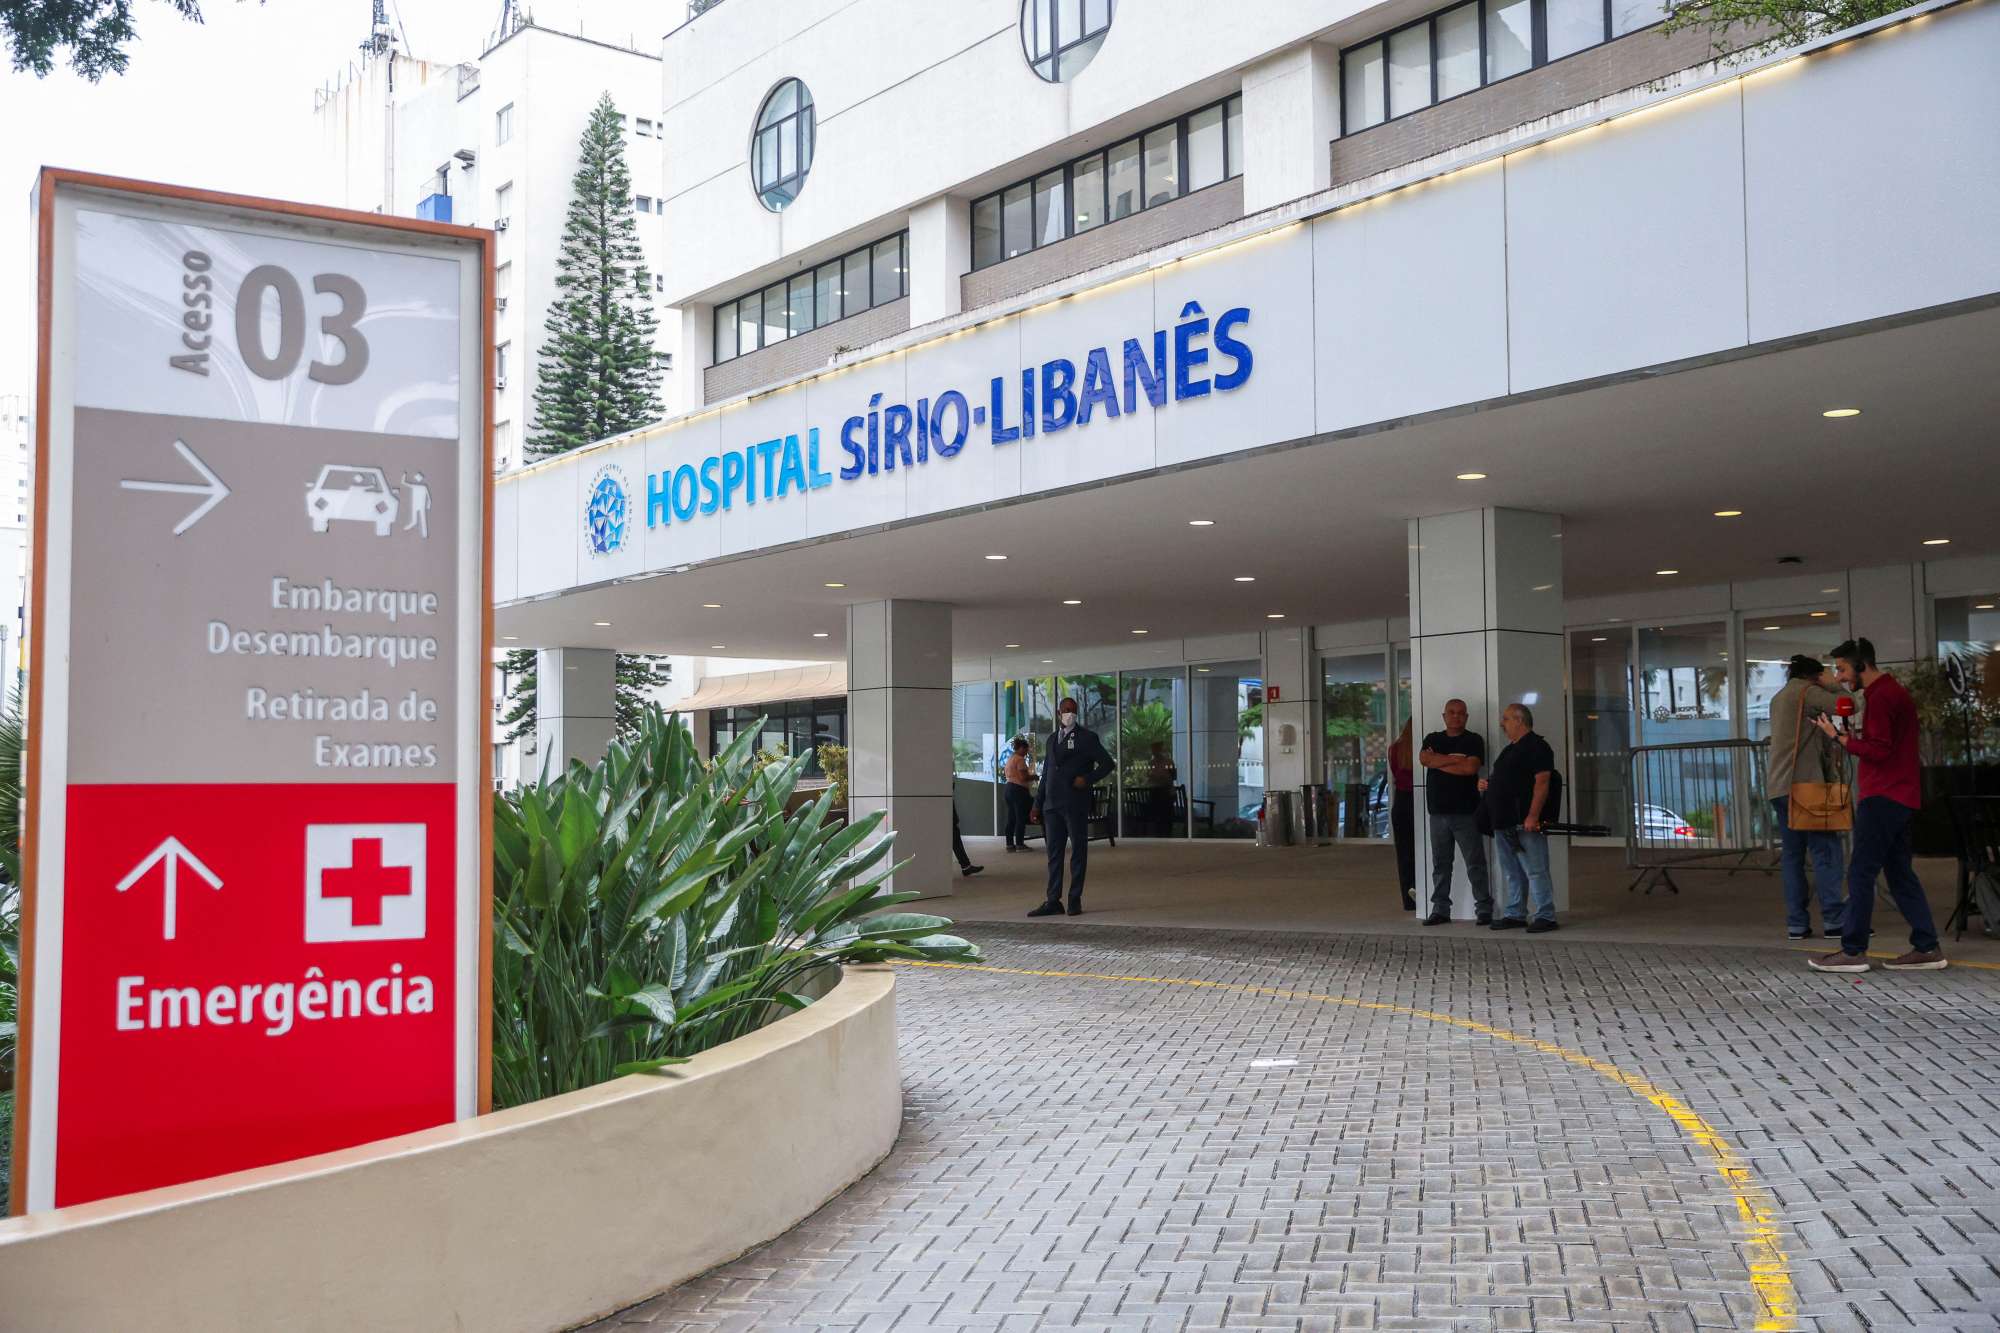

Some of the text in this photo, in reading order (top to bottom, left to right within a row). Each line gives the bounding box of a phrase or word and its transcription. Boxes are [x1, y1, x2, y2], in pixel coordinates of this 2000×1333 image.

[170, 250, 213, 377] Acesso
[235, 264, 370, 386] 03
[646, 299, 1254, 529] HOSPITAL SÍRIO-LIBANÊS
[271, 576, 439, 621] Embarque
[207, 621, 439, 668] Desembarque
[246, 687, 438, 722] Retirada de
[314, 734, 438, 768] Exames
[115, 963, 435, 1037] Emergência
